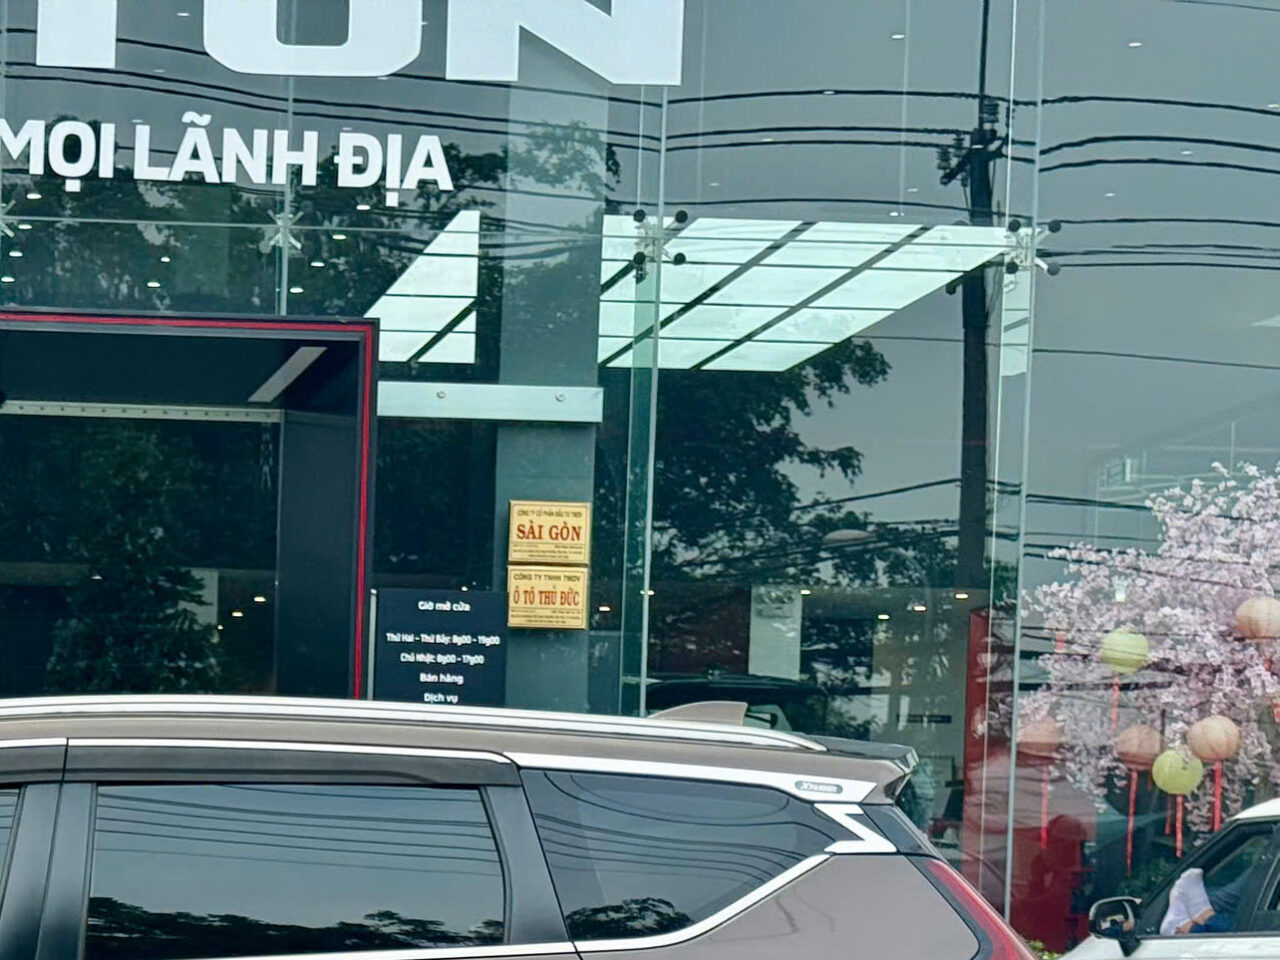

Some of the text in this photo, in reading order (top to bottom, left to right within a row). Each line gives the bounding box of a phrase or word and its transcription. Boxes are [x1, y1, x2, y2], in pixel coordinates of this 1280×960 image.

[134, 111, 318, 187] LÃNH
[334, 132, 454, 206] ĐỊA
[516, 519, 582, 541] SÀI GÒN
